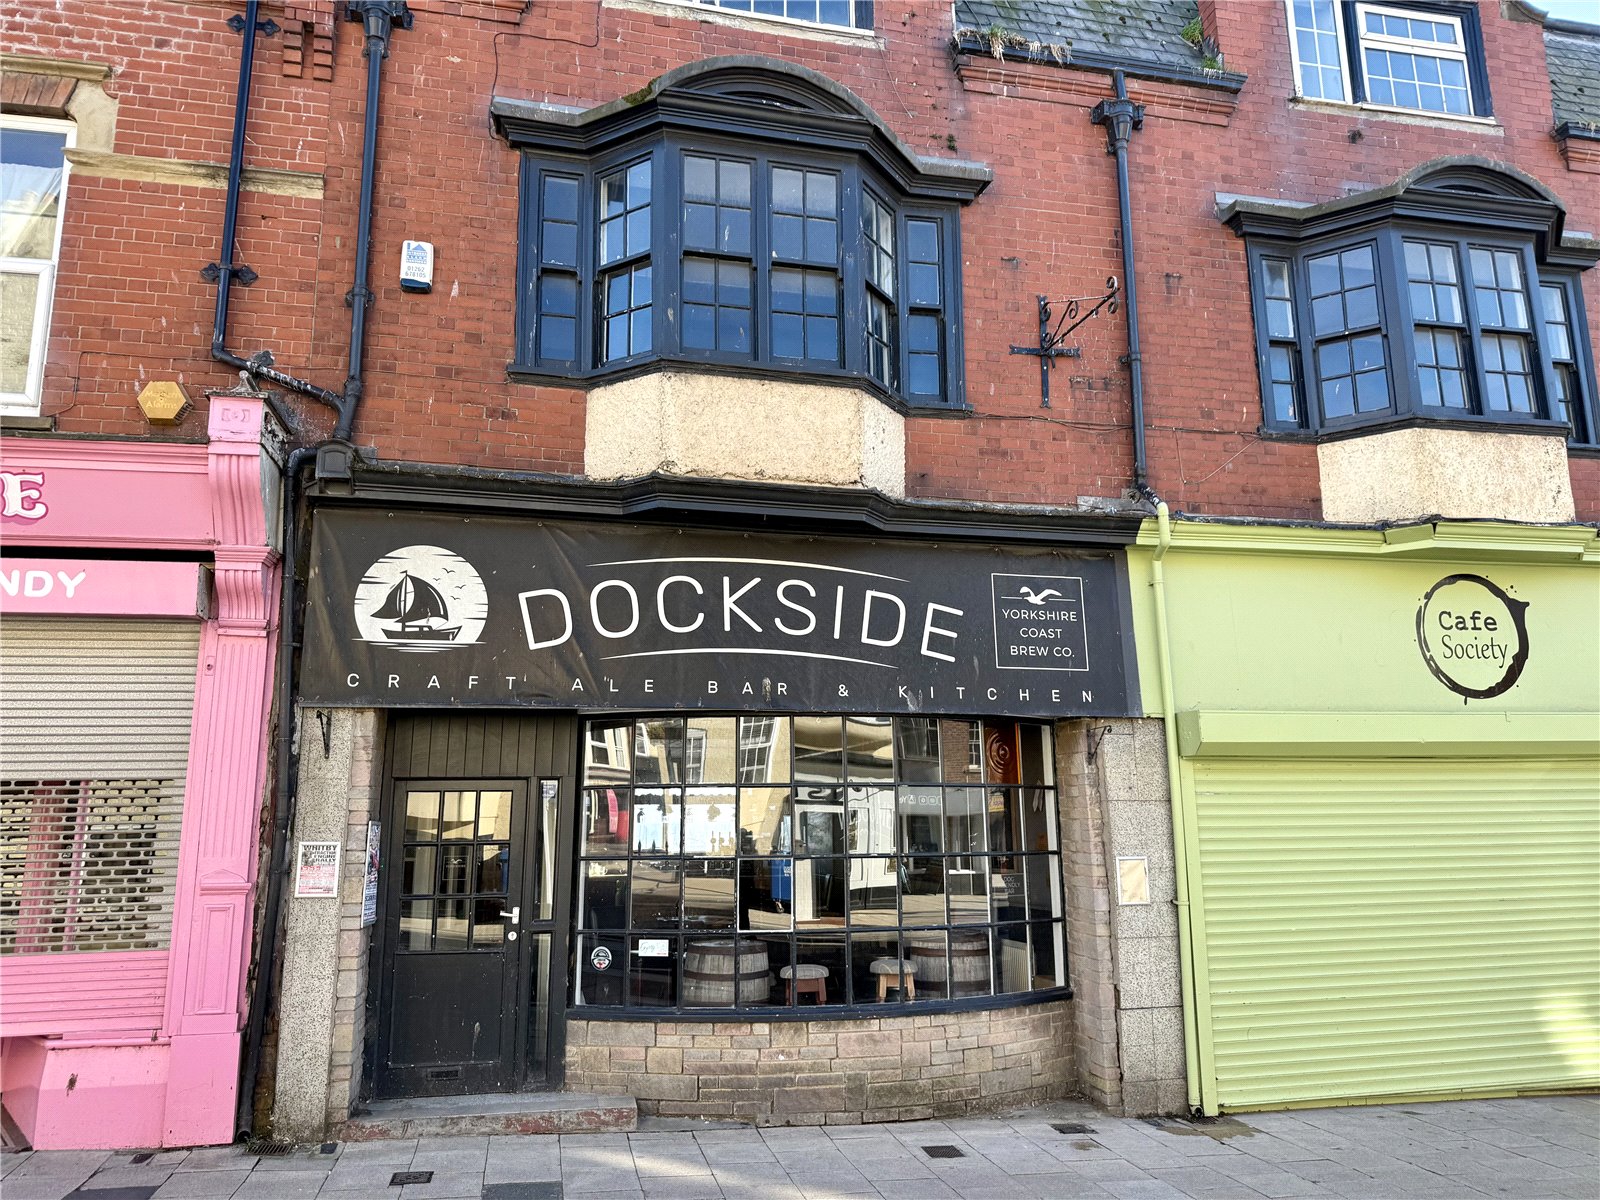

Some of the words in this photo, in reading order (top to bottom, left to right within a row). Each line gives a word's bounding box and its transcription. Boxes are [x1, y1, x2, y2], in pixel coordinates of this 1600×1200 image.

[0, 471, 49, 521] E
[518, 575, 965, 663] DOCKSIDE
[1002, 608, 1078, 622] YORKSHIRE
[1438, 610, 1498, 632] Cafe
[1020, 627, 1062, 639] COAST
[1010, 645, 1049, 657] BREW
[1053, 647, 1075, 658] CO.
[1441, 634, 1508, 669] Society
[346, 672, 517, 690] CRAFT
[571, 677, 654, 693] ALE
[707, 680, 788, 696] BAR
[837, 684, 850, 698] &
[898, 685, 1093, 703] KITCHEN
